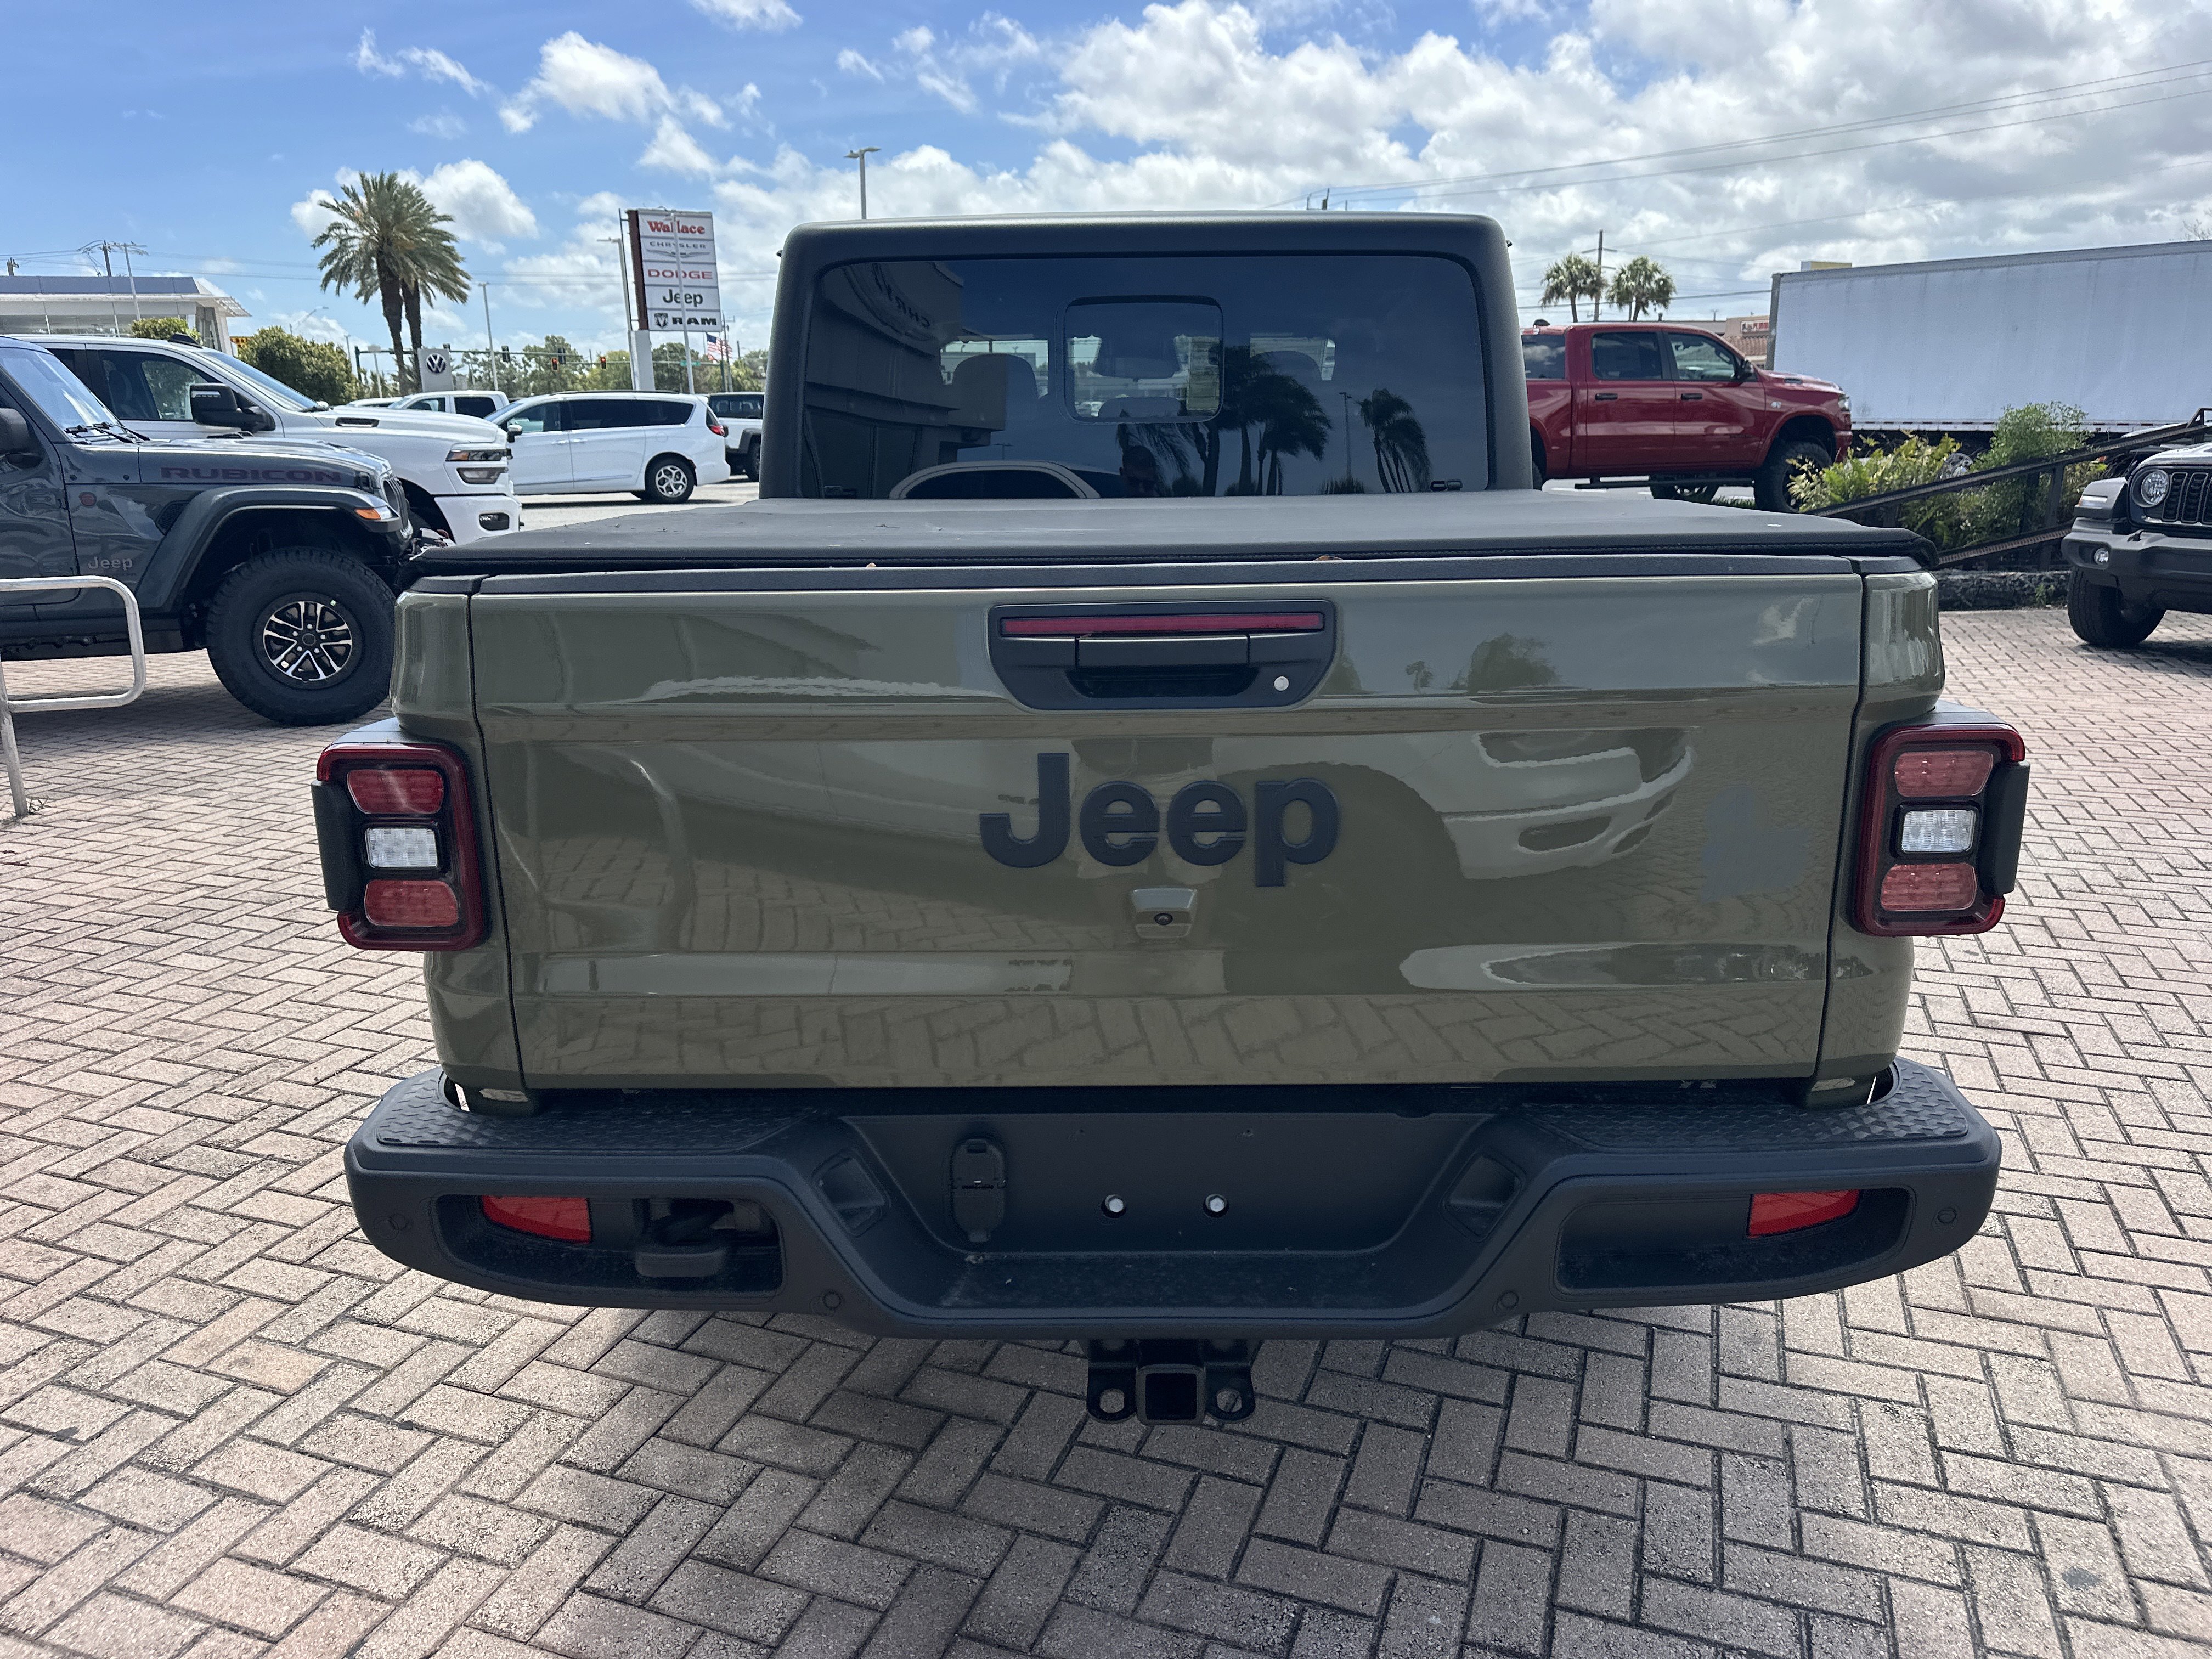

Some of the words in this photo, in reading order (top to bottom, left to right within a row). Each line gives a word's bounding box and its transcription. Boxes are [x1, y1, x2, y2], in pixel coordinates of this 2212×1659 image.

[647, 220, 705, 234] Wallace
[648, 269, 713, 279] DODGE
[663, 289, 703, 307] Jeep
[672, 317, 717, 325] RAM
[161, 467, 342, 482] RUBICON
[87, 556, 133, 571] Jeep
[979, 753, 1340, 887] Jeep
